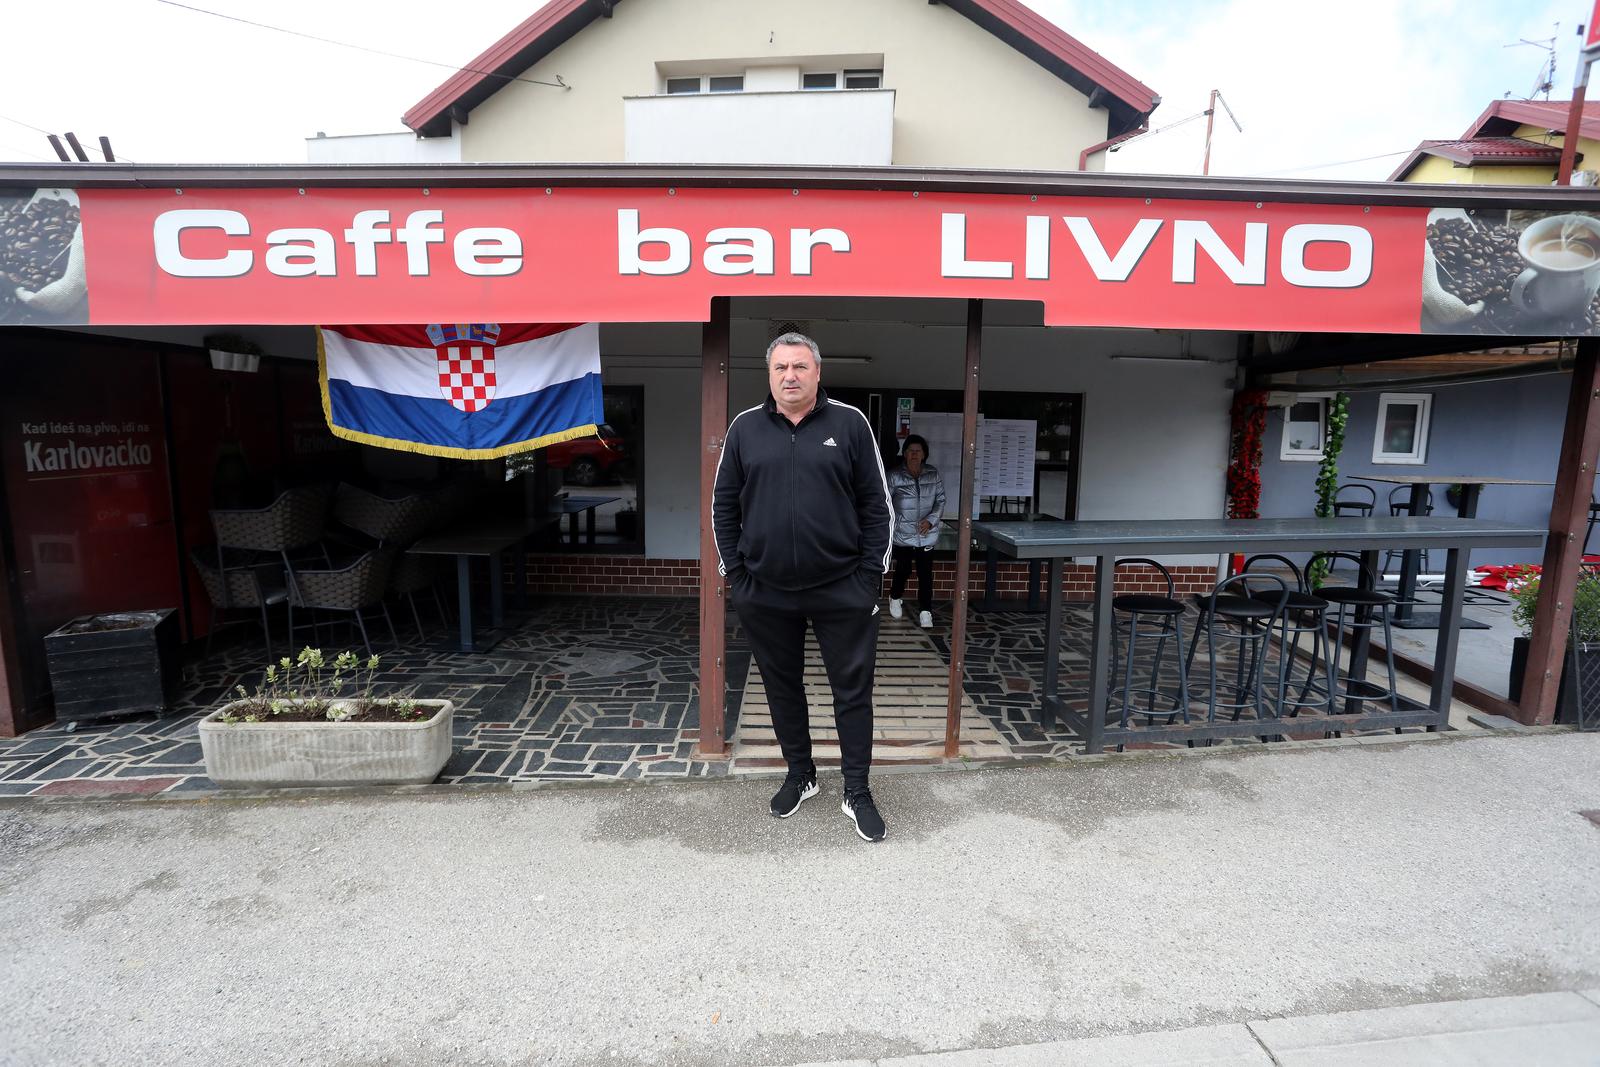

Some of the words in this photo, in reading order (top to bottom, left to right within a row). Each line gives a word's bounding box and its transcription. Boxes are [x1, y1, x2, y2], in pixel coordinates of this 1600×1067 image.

[153, 209, 523, 278] Caffe
[617, 208, 851, 276] bar
[940, 212, 1374, 289] LIVNO
[22, 422, 47, 434] Kad
[50, 421, 76, 434] ideš
[78, 424, 92, 434] na
[122, 421, 135, 433] idi
[23, 438, 152, 473] Karlovačko
